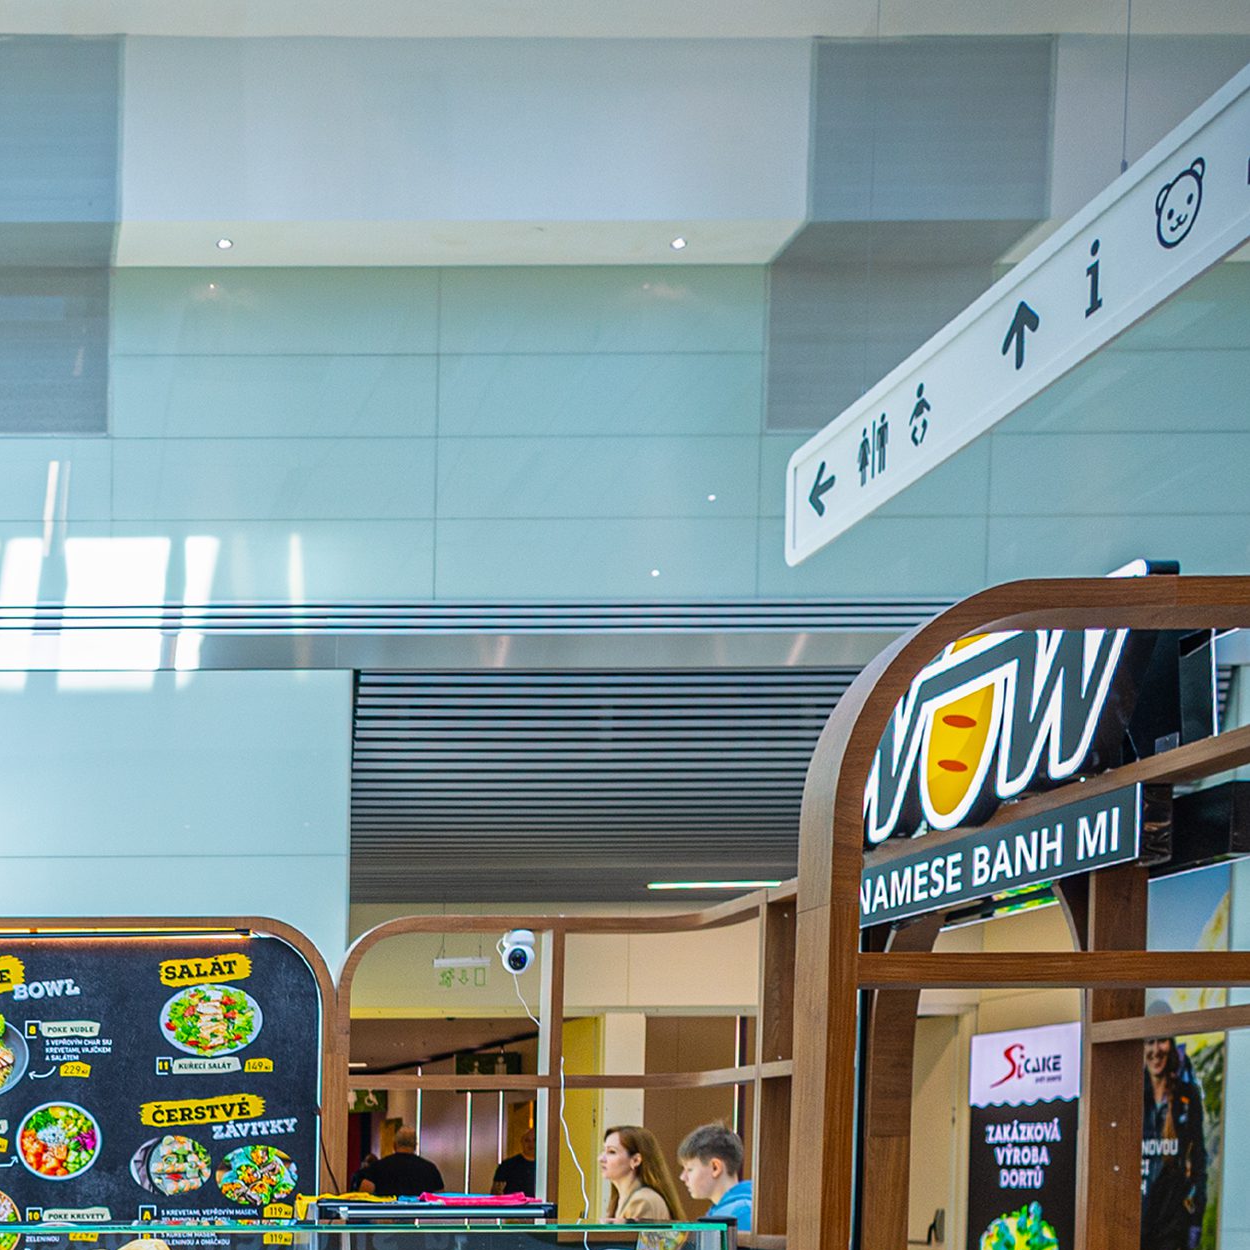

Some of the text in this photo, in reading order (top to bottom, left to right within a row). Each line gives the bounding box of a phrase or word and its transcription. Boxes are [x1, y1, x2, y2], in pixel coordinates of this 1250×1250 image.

[972, 823, 1062, 887] BANH
[1076, 807, 1119, 860] MI
[164, 957, 237, 980] SALÁT
[13, 979, 81, 1001] BOWL
[29, 1026, 37, 1034] 8
[64, 1065, 81, 1074] 229
[159, 1061, 169, 1071] 11
[178, 1060, 232, 1070] KUŘECÍ SALÁT
[247, 1062, 263, 1070] 149
[152, 1097, 250, 1124] ČERSTVÉ
[212, 1118, 298, 1140] ZÁVITKY
[986, 1117, 1060, 1144] ZAKÁZKOVÁ
[994, 1143, 1049, 1166] VÝROBA
[999, 1167, 1043, 1189] DORTŮ
[48, 1212, 105, 1220] POKE KREVETY
[270, 1207, 282, 1215] 119
[28, 1212, 39, 1221] 10
[270, 1233, 282, 1242] 119
